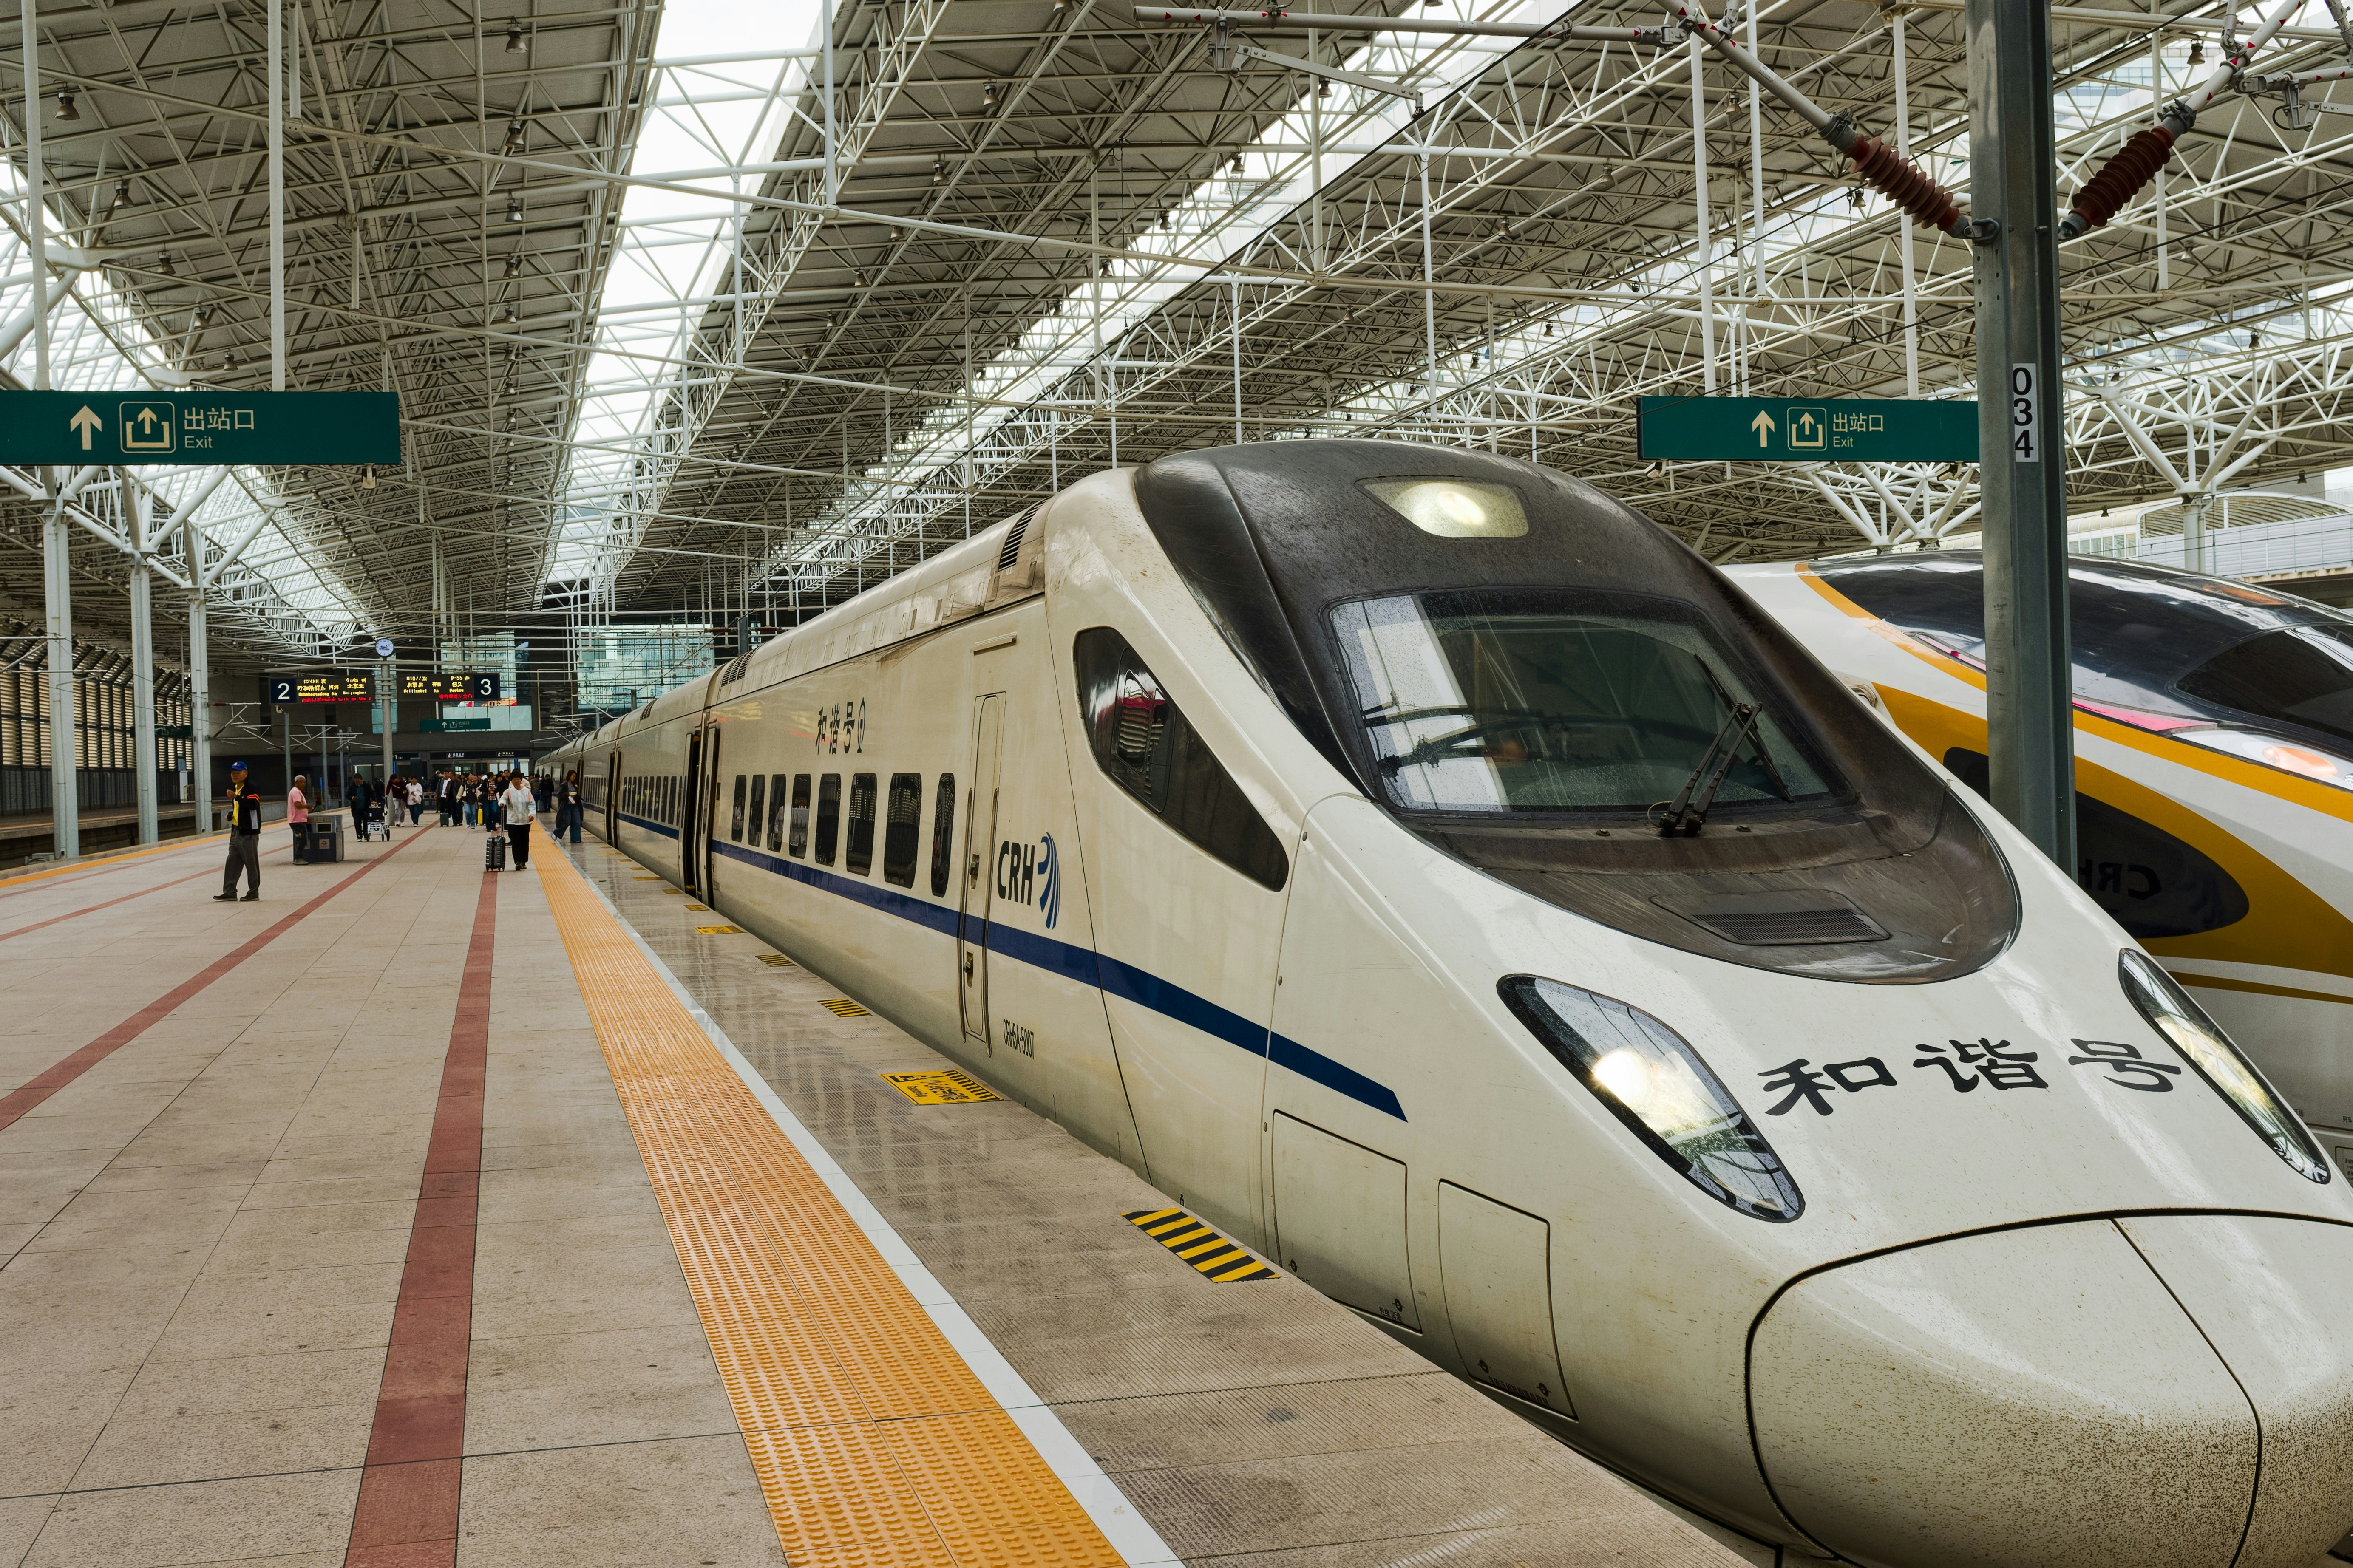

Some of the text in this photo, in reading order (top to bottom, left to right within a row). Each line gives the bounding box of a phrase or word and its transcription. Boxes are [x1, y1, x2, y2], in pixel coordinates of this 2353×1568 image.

[184, 407, 254, 430] 出站口
[1833, 412, 1883, 433] 出站口
[2013, 367, 2034, 458] 034
[184, 436, 213, 448] Exit
[1833, 436, 1853, 447] Exit
[278, 683, 290, 700] 2
[480, 679, 492, 695] 3
[815, 701, 855, 755] 和谐号
[997, 840, 1035, 906] CRH
[1003, 1018, 1034, 1059] CRH5A-5007
[1758, 1037, 2182, 1116] 和谐号
